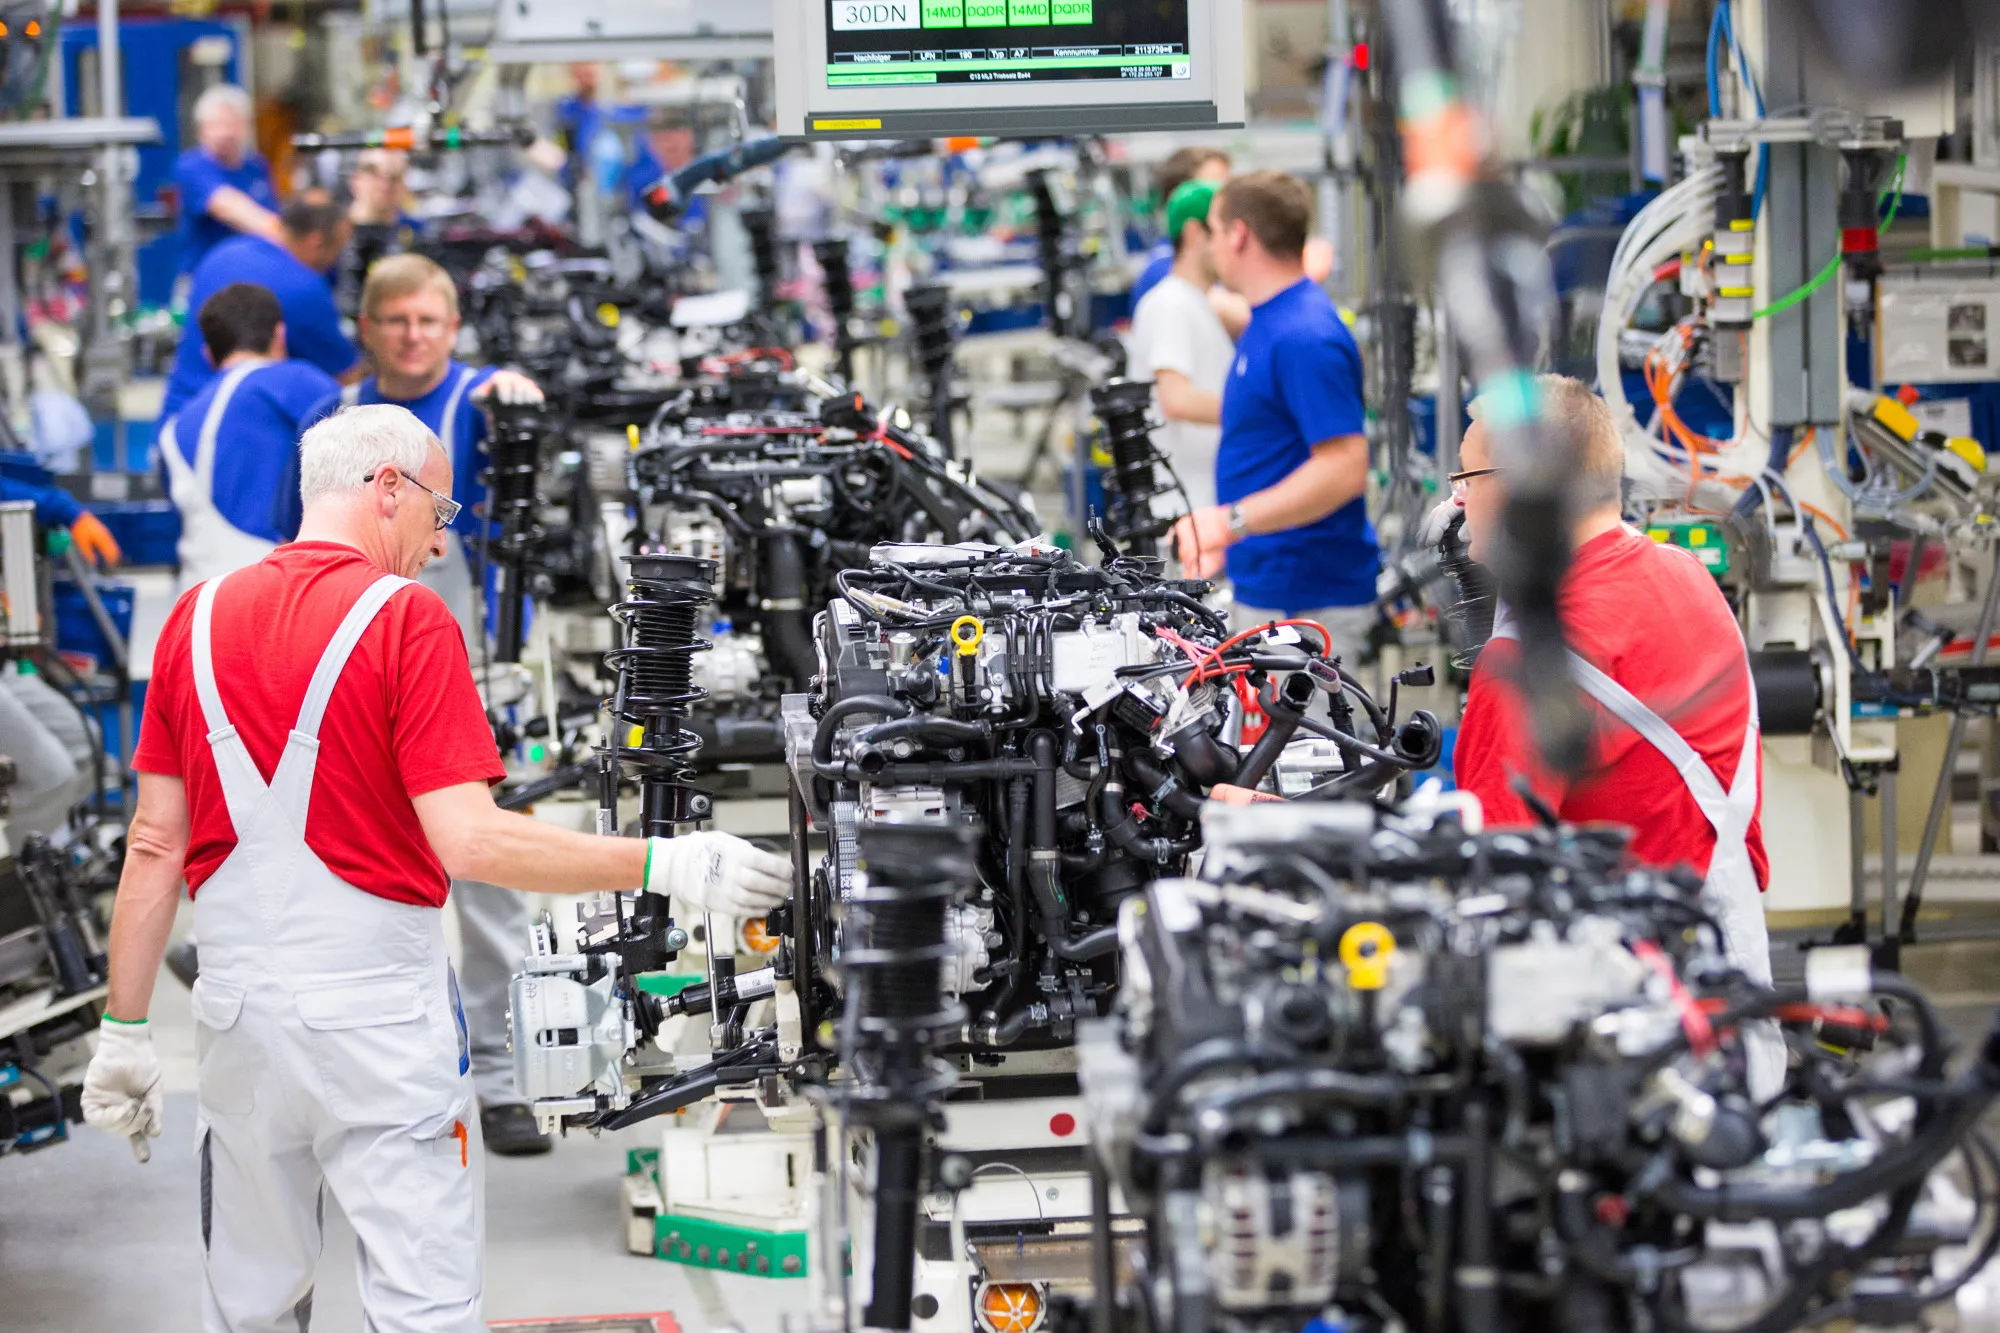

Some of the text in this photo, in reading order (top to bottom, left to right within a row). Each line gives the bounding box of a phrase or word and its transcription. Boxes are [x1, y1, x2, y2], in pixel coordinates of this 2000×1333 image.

[846, 3, 1090, 24] 30DN 14MD DQDR 14MD DQDR
[991, 50, 1005, 60] Typ
[1054, 48, 1100, 57] Kennnummer
